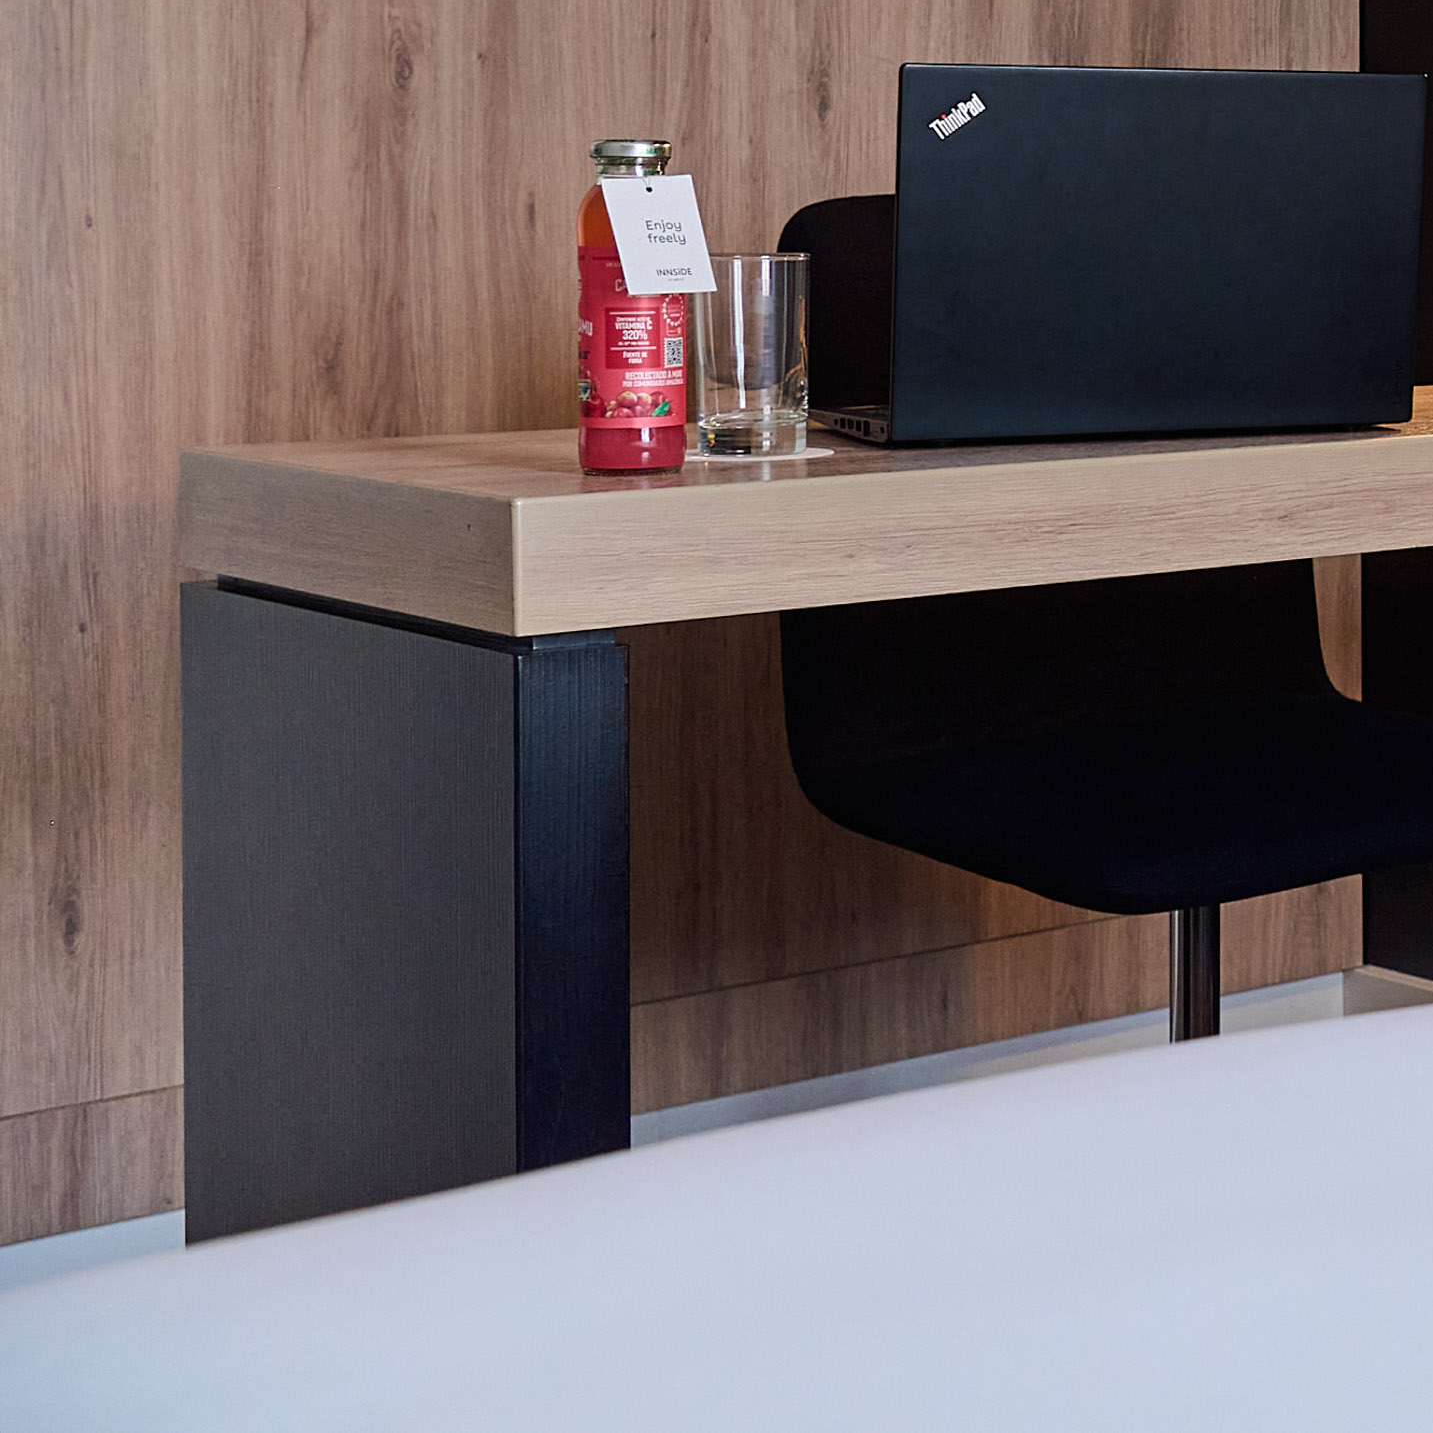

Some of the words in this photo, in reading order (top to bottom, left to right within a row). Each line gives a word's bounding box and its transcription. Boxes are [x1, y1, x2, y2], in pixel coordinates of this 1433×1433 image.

[929, 93, 986, 140] ThinkPad
[645, 219, 682, 232] Enjoy
[647, 233, 686, 245] freely
[647, 320, 653, 330] C
[622, 330, 648, 340] 320%
